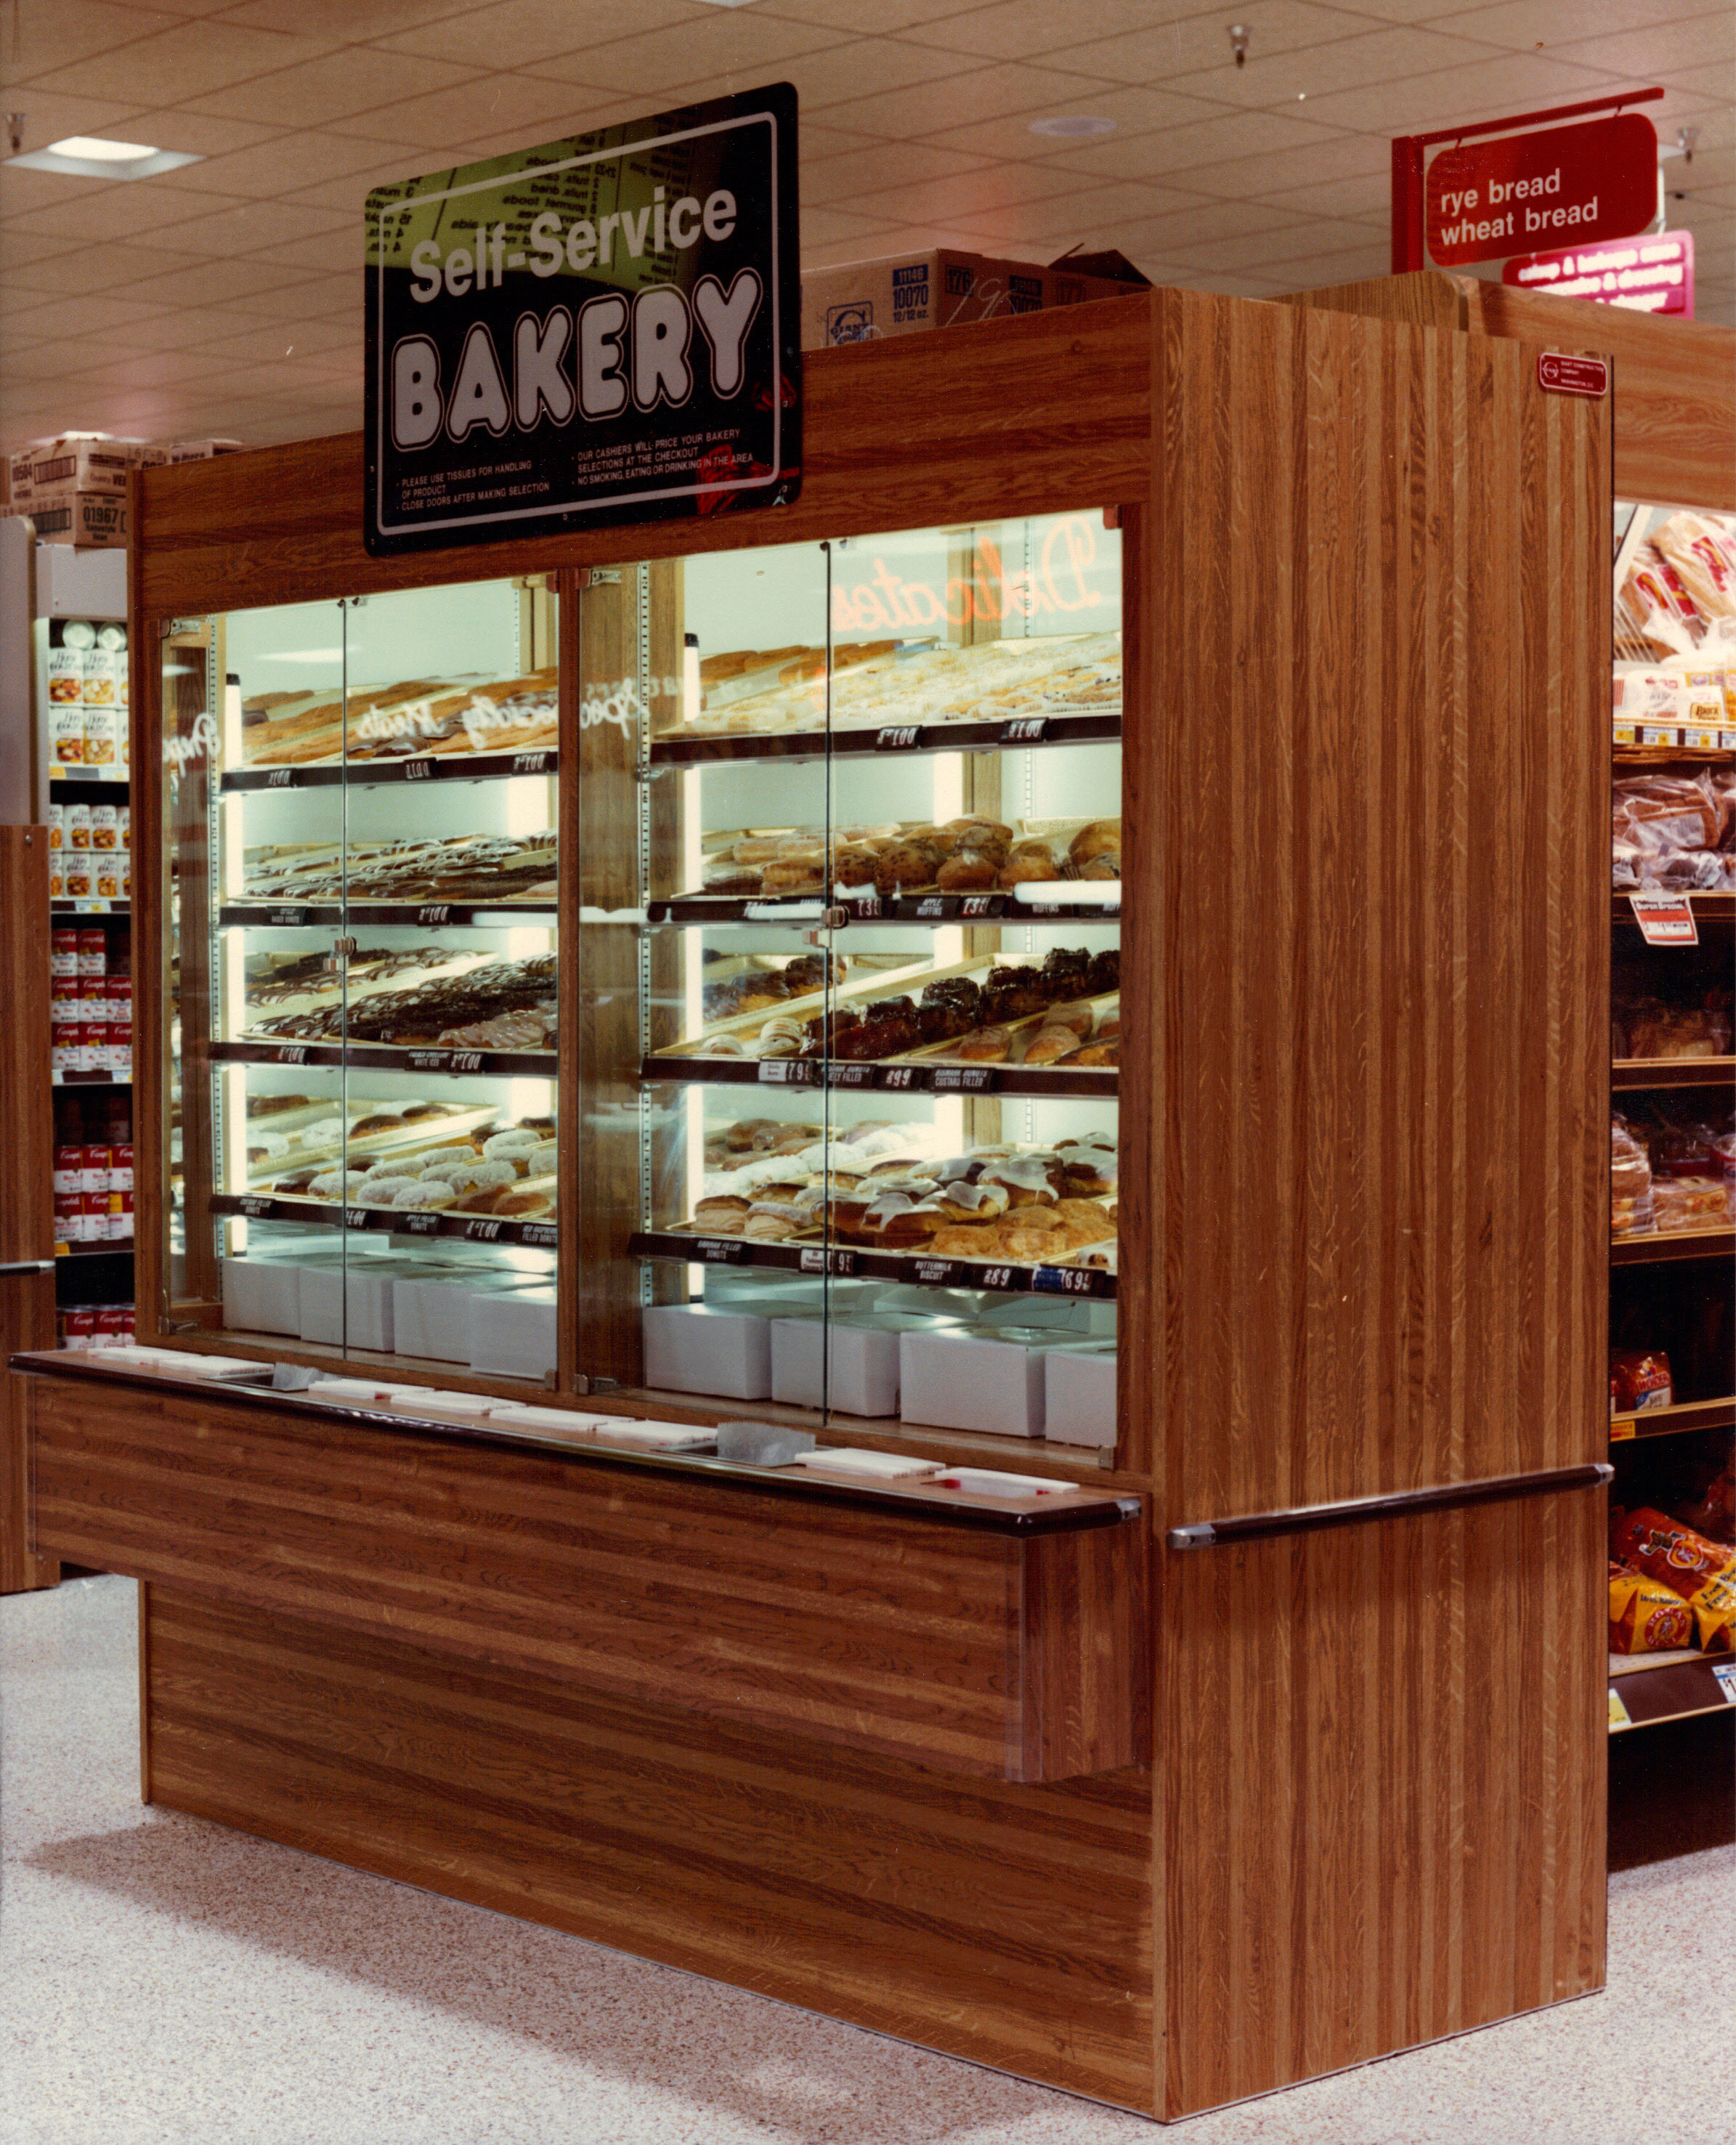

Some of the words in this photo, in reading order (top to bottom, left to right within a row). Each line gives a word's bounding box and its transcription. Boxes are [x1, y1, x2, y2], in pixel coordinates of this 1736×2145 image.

[1440, 188, 1478, 218] rye
[1489, 168, 1560, 206] bread
[1441, 214, 1514, 246] wheat
[1525, 196, 1599, 232] bread
[410, 186, 737, 303] Self-Service
[893, 284, 928, 310] 10070
[392, 267, 763, 453] BAKERY
[577, 451, 593, 462] OUR
[596, 443, 632, 460] CASHIERS
[635, 440, 653, 453] WILL
[655, 437, 678, 450] PRICE
[681, 434, 703, 445] YOUR
[706, 428, 740, 442] BAKERY
[402, 476, 428, 488] PLEASE
[430, 472, 445, 483] USE
[447, 469, 476, 481] TISSUES
[479, 465, 492, 477] FOR
[495, 460, 532, 474] HANDLING
[577, 458, 624, 474] SELECTIONS
[626, 455, 635, 466] AT
[638, 453, 652, 465] THE
[655, 446, 699, 461] CHECKOUT
[577, 477, 588, 486] NO
[625, 466, 652, 479] EATING
[653, 463, 664, 474] OR
[665, 458, 702, 473] DRINKING
[703, 456, 712, 466] IN
[713, 455, 729, 466] THE
[731, 452, 753, 463] AREA
[402, 490, 411, 500] OF
[413, 484, 446, 498] PRODUCT
[402, 499, 424, 511] CLOSE
[426, 495, 450, 507] DOORS
[453, 492, 476, 504] AFTER
[478, 487, 506, 500] MAKING
[508, 482, 550, 496] SELECTION
[84, 506, 118, 524] 01967
[1695, 705, 1719, 717] BRICK
[915, 1260, 952, 1272] BUTTERMILK
[920, 1270, 944, 1280] BISCUIT
